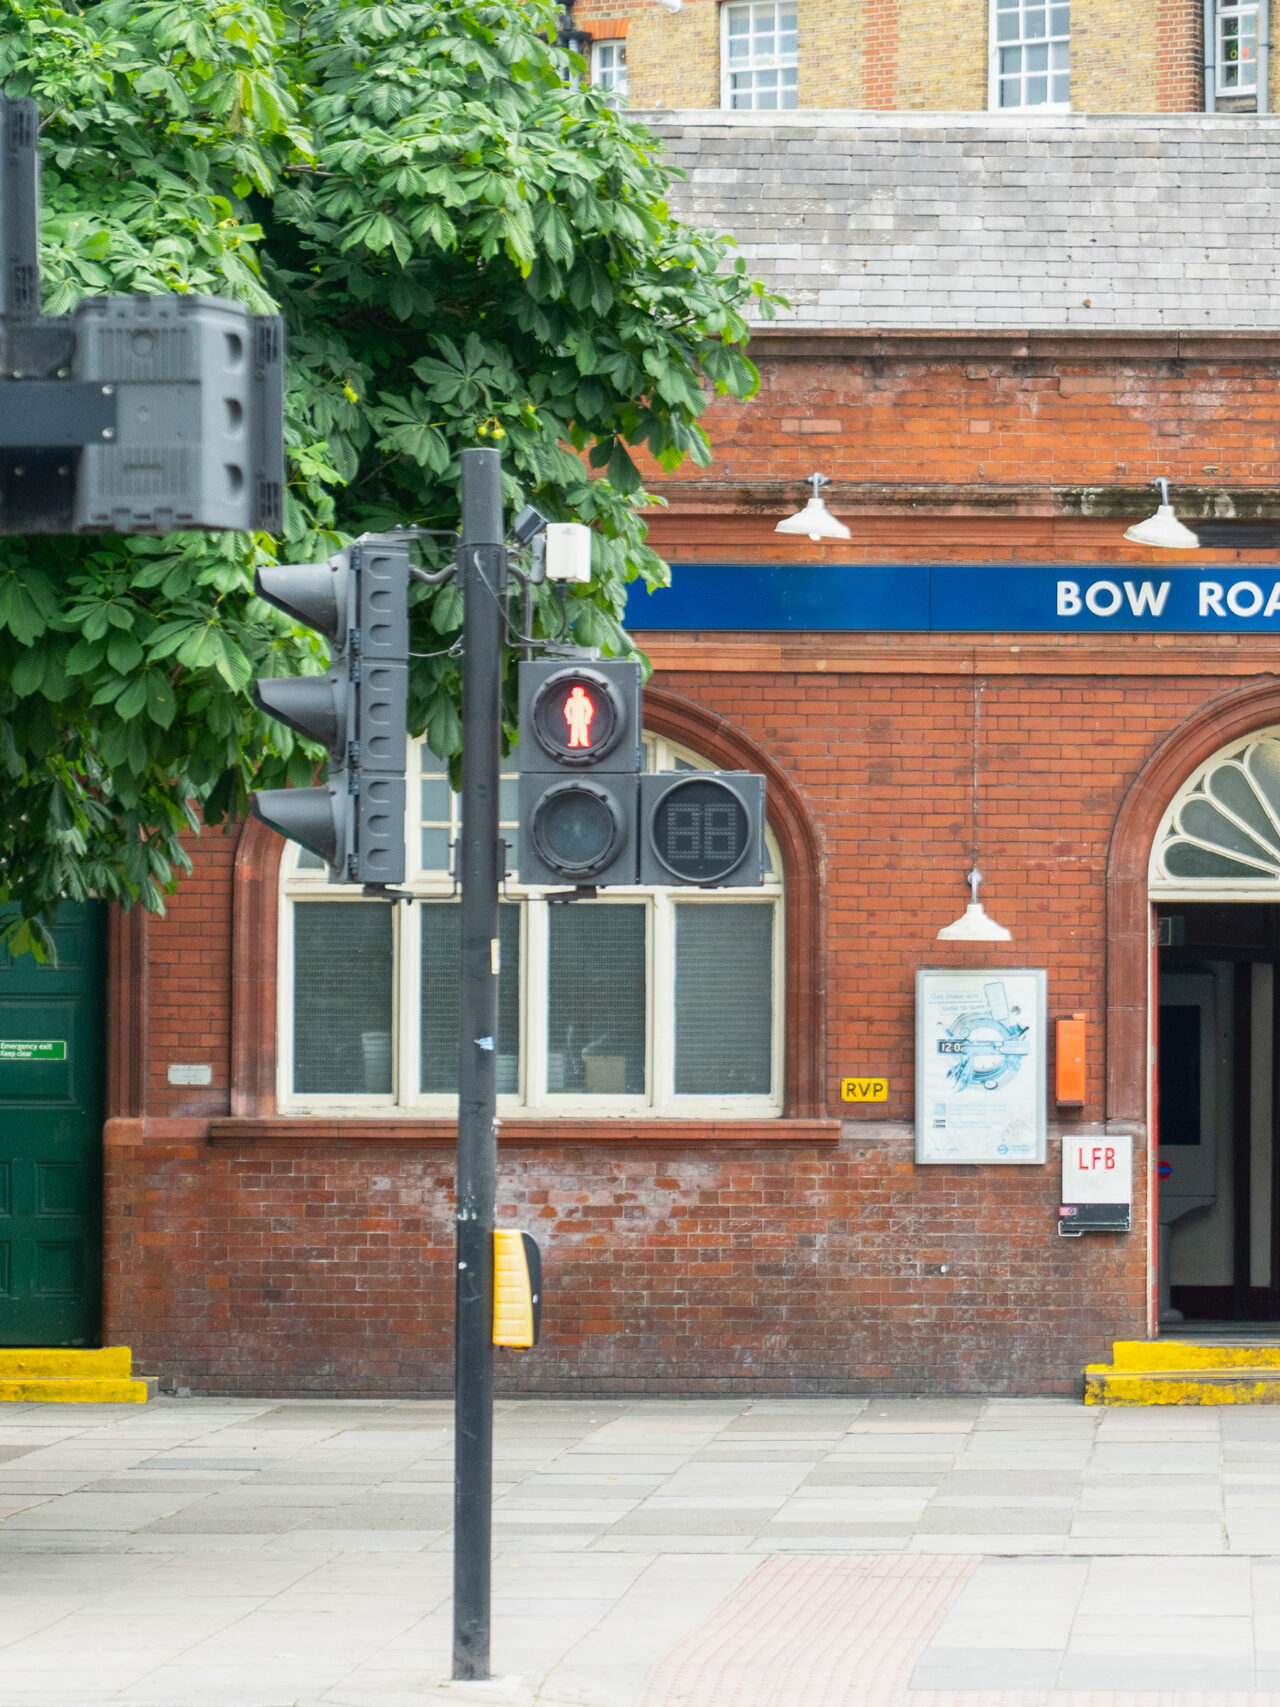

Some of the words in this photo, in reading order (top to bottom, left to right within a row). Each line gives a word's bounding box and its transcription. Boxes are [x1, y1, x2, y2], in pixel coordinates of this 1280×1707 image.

[1057, 581, 1171, 616] BOW
[847, 1083, 884, 1097] RVP
[1078, 1147, 1116, 1170] LFB
